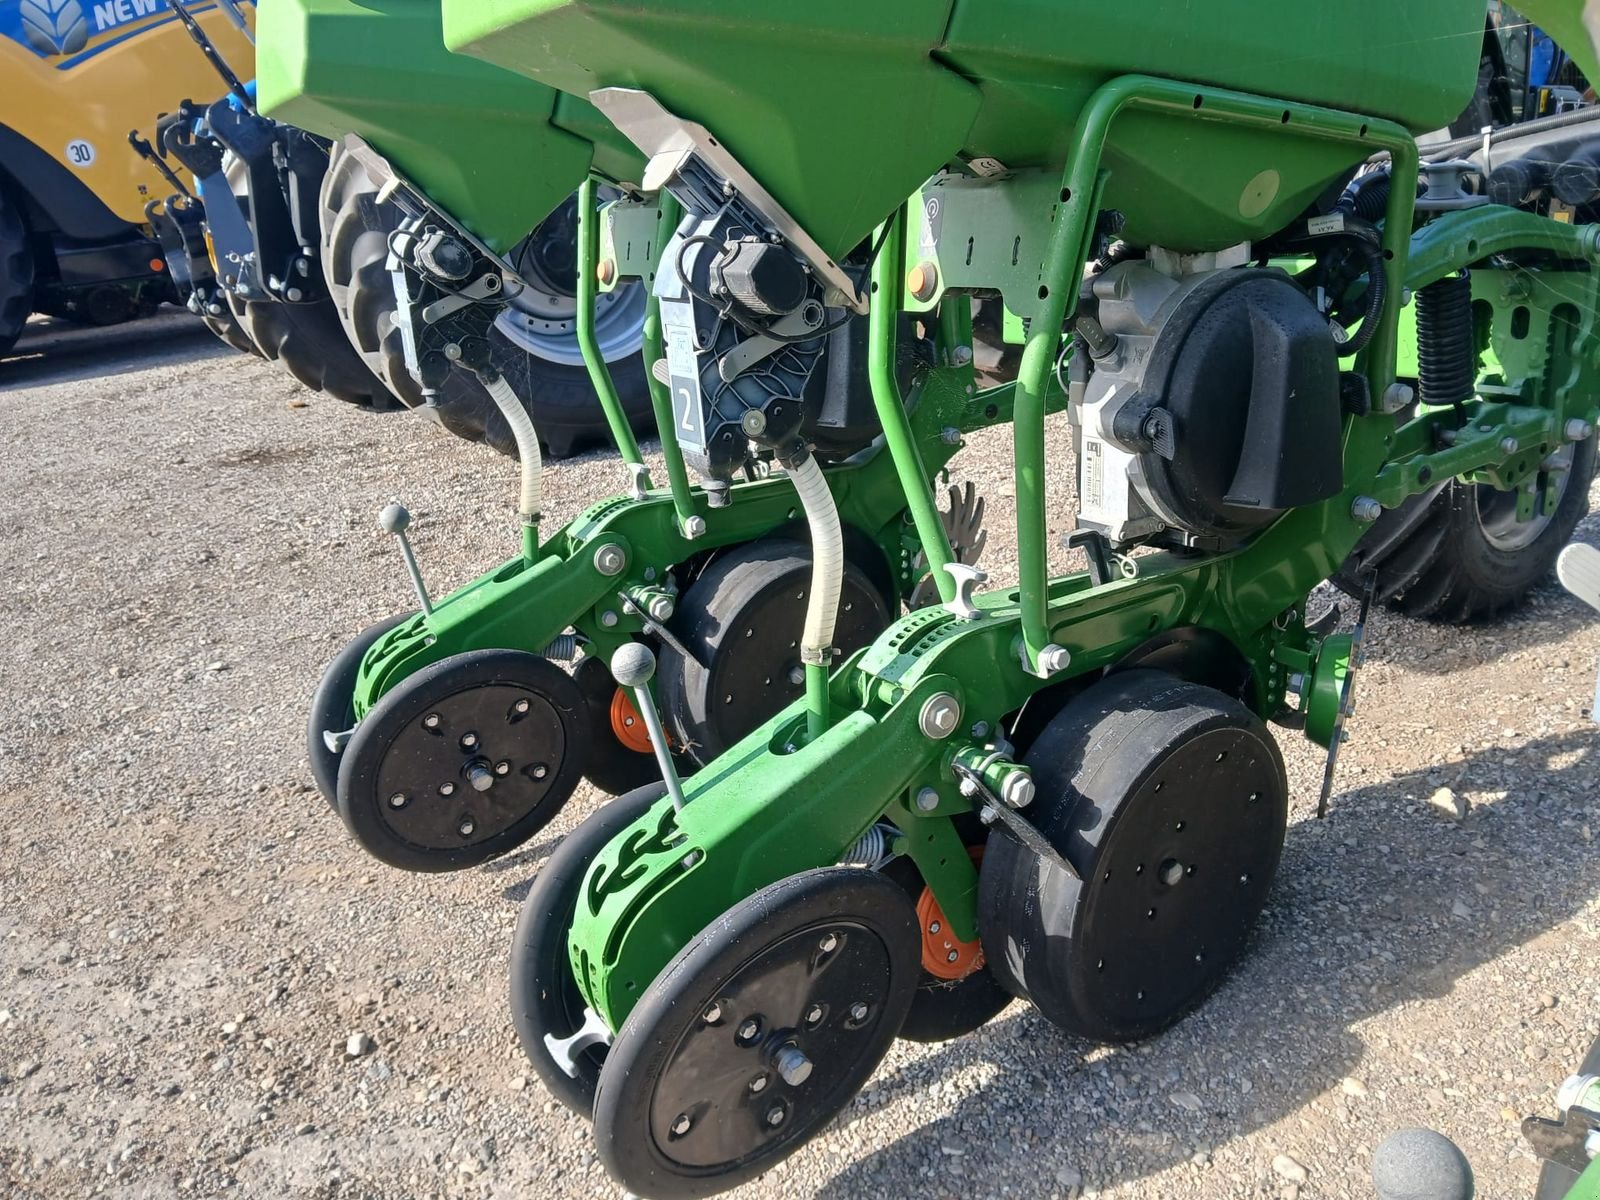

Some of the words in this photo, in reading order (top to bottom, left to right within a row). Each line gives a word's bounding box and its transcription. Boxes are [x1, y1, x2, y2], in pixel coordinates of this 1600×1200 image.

[93, 0, 156, 31] NEW
[70, 143, 91, 163] 30
[678, 388, 695, 431] 2
